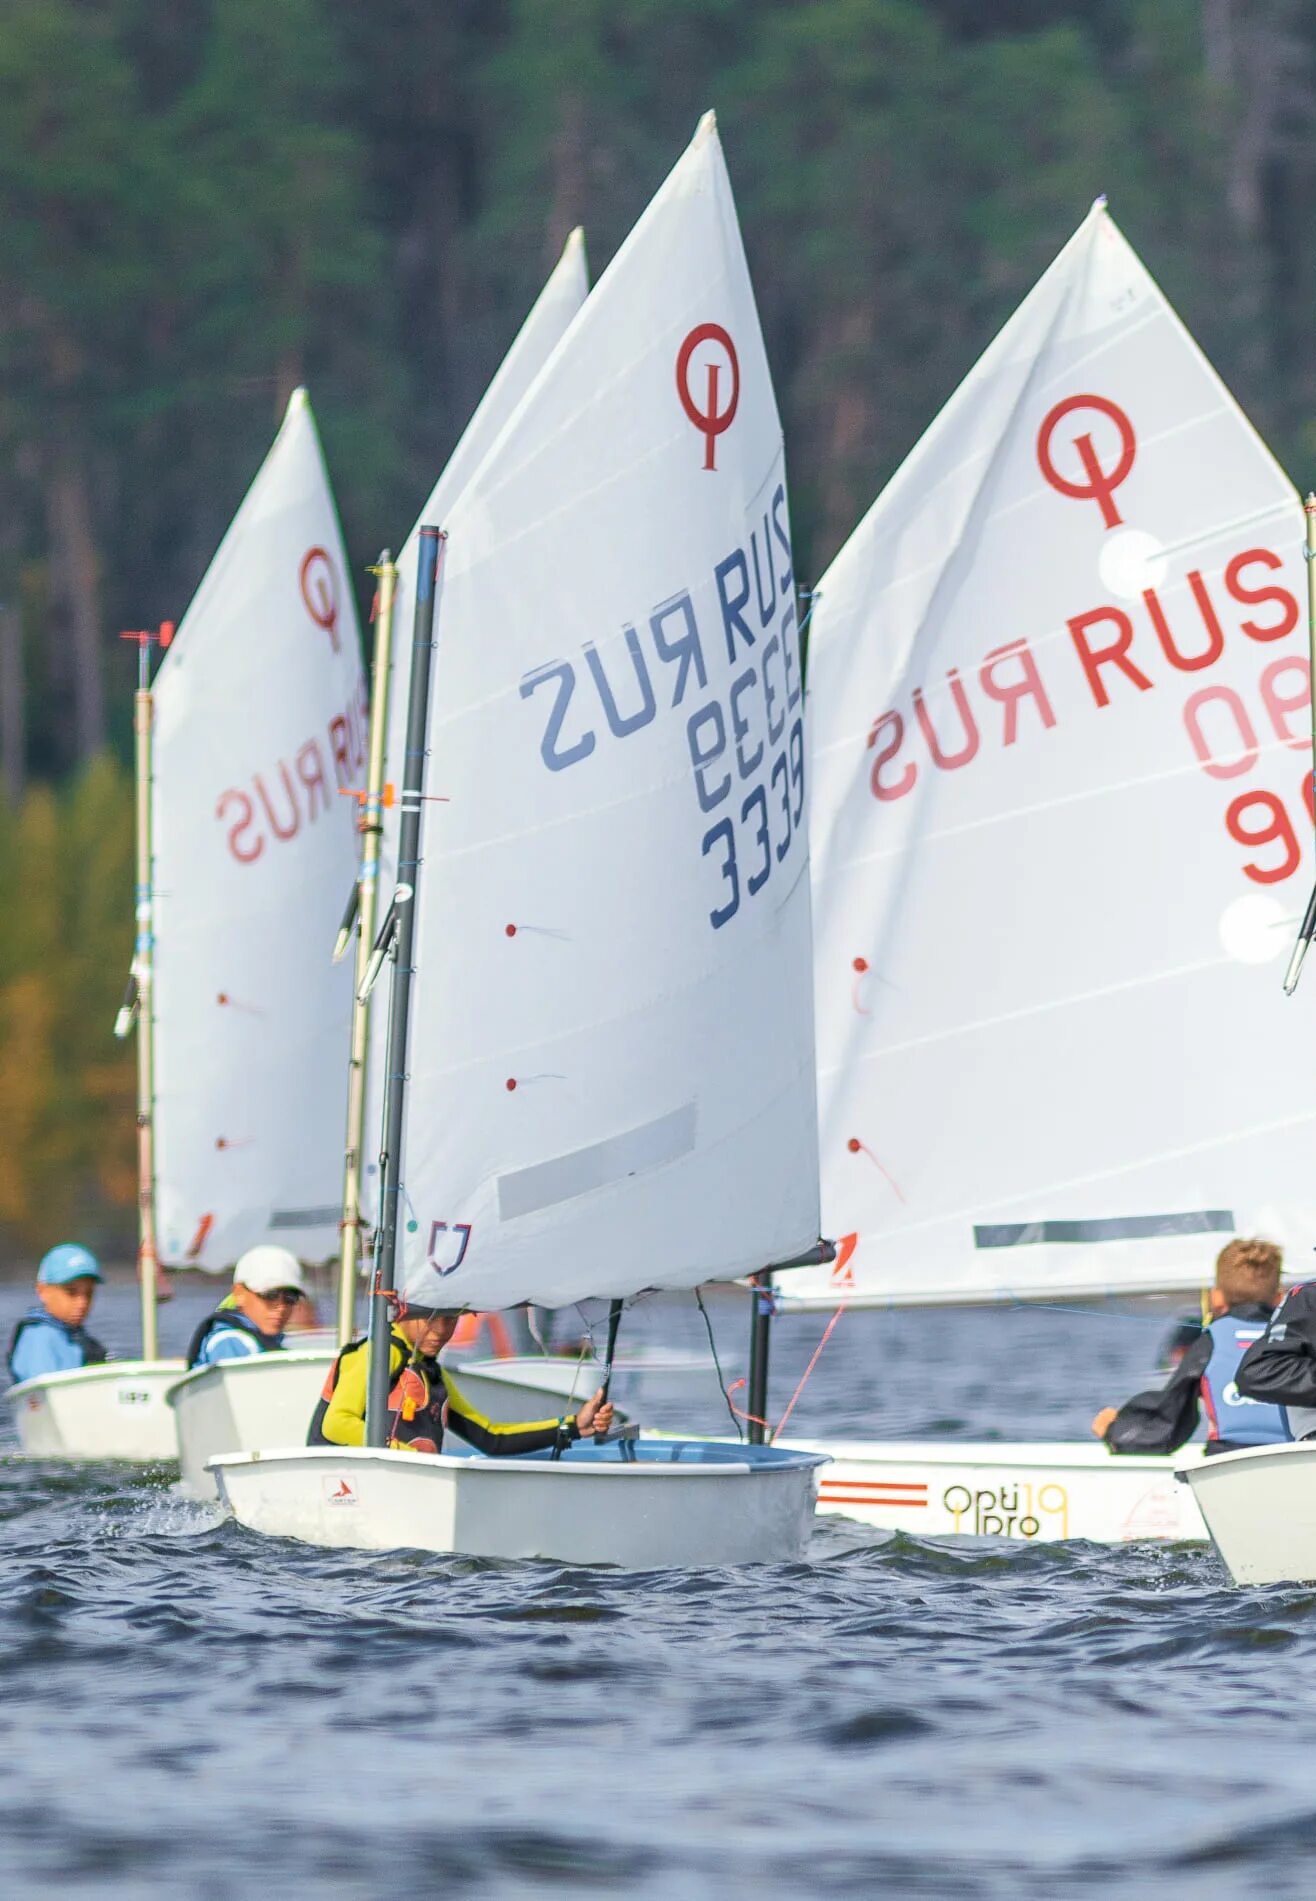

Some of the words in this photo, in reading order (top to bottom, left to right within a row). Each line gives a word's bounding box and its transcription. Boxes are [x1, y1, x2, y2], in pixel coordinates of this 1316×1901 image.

[714, 483, 794, 665] RUS
[1066, 548, 1300, 708] RUS
[702, 718, 804, 929] 3339
[1224, 769, 1314, 884] 9
